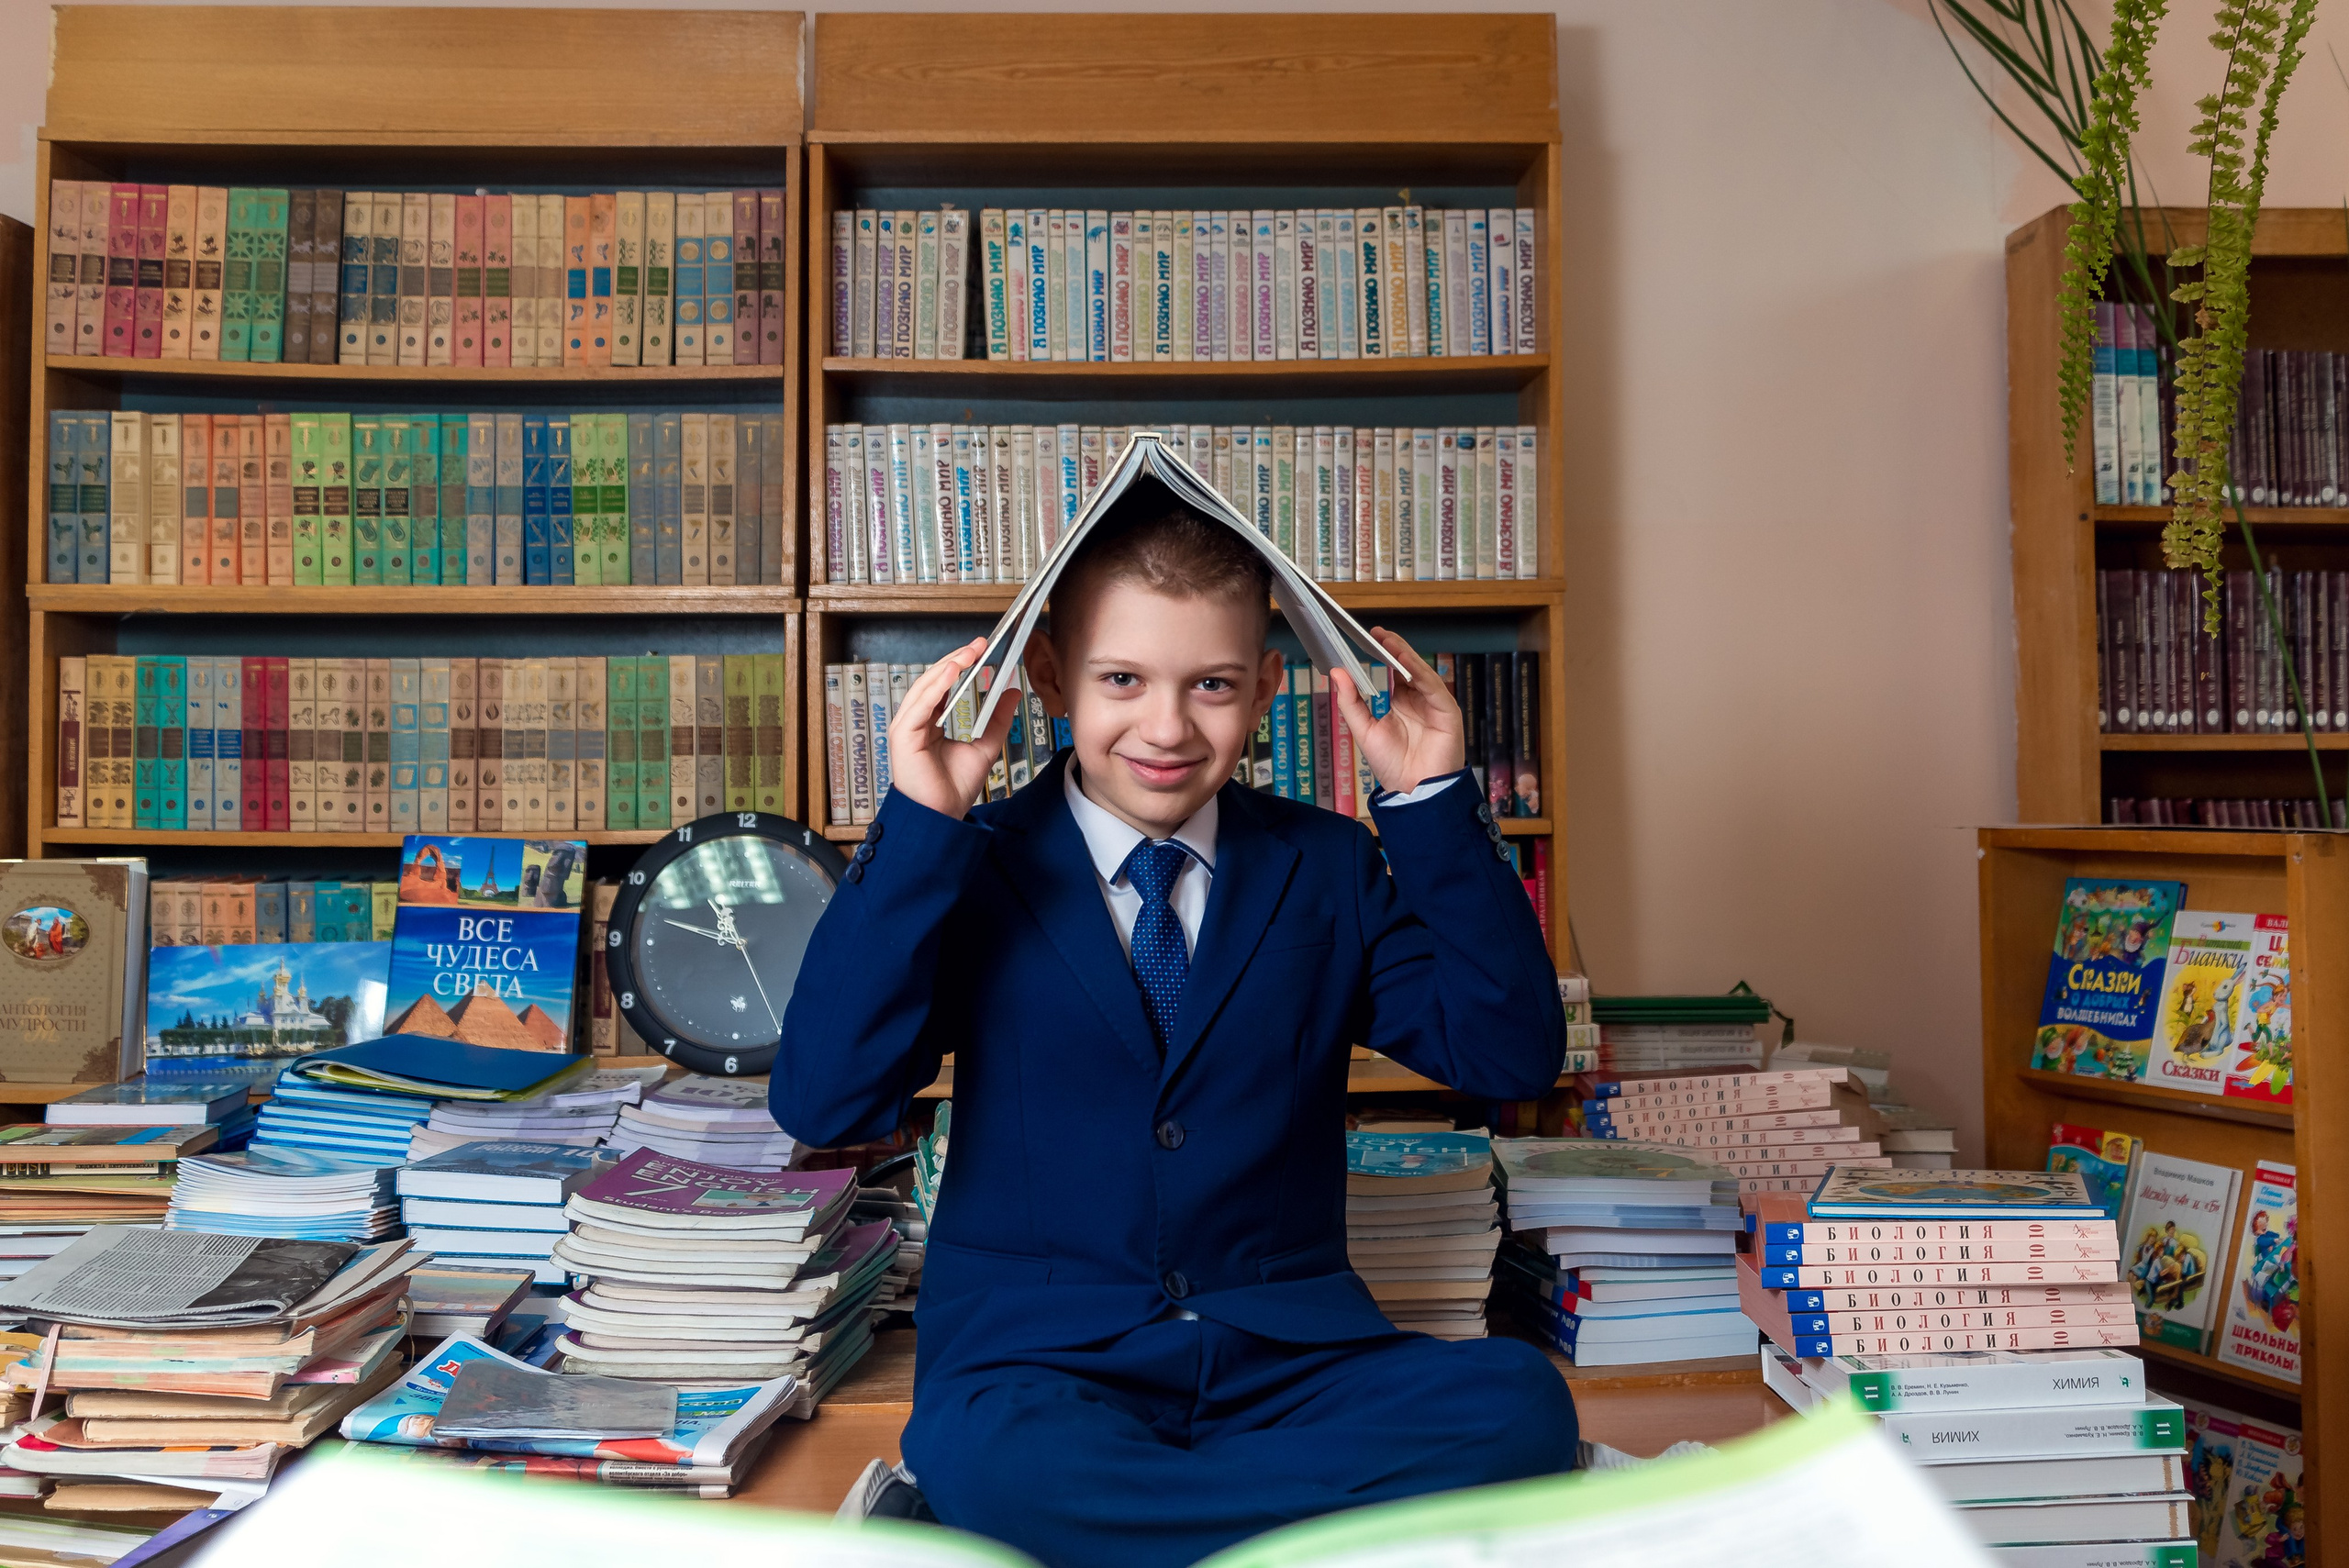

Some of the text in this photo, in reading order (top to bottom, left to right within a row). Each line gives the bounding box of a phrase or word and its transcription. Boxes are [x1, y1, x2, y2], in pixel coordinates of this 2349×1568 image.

[898, 245, 912, 278] МИР
[989, 240, 1002, 273] МИР
[1031, 245, 1044, 274] МИР
[1158, 250, 1170, 279] МИР
[1258, 252, 1270, 281] МИР
[1301, 240, 1314, 272] МИР
[1364, 241, 1377, 274] МИР
[1472, 242, 1485, 273] МИР
[1520, 239, 1533, 270] МИР
[897, 281, 911, 341] ПОЗНАЮ
[989, 278, 1006, 339] ПОЗНАЮ
[1033, 278, 1046, 335] ПОЗНАЮ
[1158, 283, 1169, 340] ПОЗНАЮ
[1258, 284, 1270, 341] ПОЗНАЮ
[1300, 276, 1315, 338] ПОЗНАЮ
[1365, 278, 1380, 339] ПОЗНАЮ
[1472, 277, 1485, 338] ПОЗНАЮ
[1520, 274, 1534, 336] ПОЗНАЮ
[938, 460, 951, 492] МИР
[1319, 465, 1330, 494] МИР
[1400, 467, 1411, 495] МИР
[1442, 465, 1455, 495] МИР
[1500, 459, 1513, 490] МИР
[938, 495, 954, 559] ПОЗНАЮ
[1319, 497, 1330, 554] ПОЗНАЮ
[1399, 500, 1412, 555] ПОЗНАЮ
[1442, 497, 1454, 555] ПОЗНАЮ
[1499, 494, 1513, 559] ПОЗНАЮ
[829, 703, 842, 730] МИР
[851, 699, 865, 730] МИР
[873, 703, 887, 733] МИР
[1276, 704, 1286, 738] ВСЕХ
[1318, 703, 1329, 737] ВСЕХ
[1033, 719, 1047, 745] ВСЕ
[1277, 741, 1286, 770] ОБО
[1297, 700, 1310, 795] ВСЁ ОБО ВСЕХ
[1319, 740, 1329, 768] ОБО
[829, 734, 846, 795] ПОЗНАЮ
[852, 734, 867, 795] ПОЗНАЮ
[1338, 739, 1351, 795] ВСЁ ОБО
[737, 813, 756, 828] 12
[677, 828, 693, 842] 11
[803, 830, 811, 846] 1
[629, 871, 644, 884] 10
[459, 917, 513, 943] ВСЕ
[609, 931, 621, 947] 9
[427, 944, 540, 972] ЧУДЕСА
[2174, 940, 2247, 970] Бианки
[433, 972, 524, 998] СВЕТА
[2, 1004, 86, 1016] АНТОЛОГИЯ
[620, 993, 633, 1009] 8
[0, 1018, 85, 1031] МУДРОСТИ
[663, 1040, 675, 1055] 7
[725, 1057, 737, 1073] 6
[1783, 1073, 1794, 1083] 10
[2162, 1060, 2221, 1082] Сказки
[1638, 1075, 1756, 1093] БИОЛОГИЯ
[1766, 1085, 1777, 1095] 10
[1625, 1089, 1741, 1108] БИОЛОГИЯ
[1768, 1100, 1778, 1109] 10
[1628, 1103, 1742, 1123] БИОЛОГИЯ
[1776, 1117, 1787, 1127] 10
[1634, 1118, 1750, 1137] БИОЛОГИЯ
[1793, 1130, 1804, 1140] 10
[1348, 1144, 1466, 1152] GLISH
[1813, 1147, 1824, 1156] 10
[624, 1174, 688, 1196] 7
[634, 1168, 819, 1195] ENGLISH
[644, 1162, 778, 1186] ENJOY
[1637, 1168, 1674, 1177] 7
[2154, 1168, 2214, 1186] Владимир Машков
[603, 1195, 692, 1213] Student's
[1828, 1225, 1993, 1240] БИОЛОГИЯ
[2028, 1224, 2044, 1239] 10
[1827, 1245, 1993, 1262] БИОЛОГИЯ
[2030, 1244, 2046, 1259] 10
[1823, 1268, 1992, 1284] БИОЛОГИЯ
[2026, 1266, 2044, 1281] 10
[1848, 1290, 2011, 1307] БИОЛОГИЯ
[2045, 1287, 2062, 1303] 10
[1854, 1312, 2016, 1330] БИОЛОГИЯ
[2050, 1309, 2066, 1324] 10
[1856, 1333, 2019, 1352] БИОЛОГИЯ
[2054, 1330, 2070, 1345] 10
[2232, 1325, 2301, 1355] ШКОЛЬНЫ
[2231, 1343, 2299, 1371] «ПРИКОЛЫ»
[1864, 1386, 1879, 1399] 11
[2053, 1377, 2099, 1390] ХИМИЯ
[1932, 1431, 1980, 1443] ХИМИЯ
